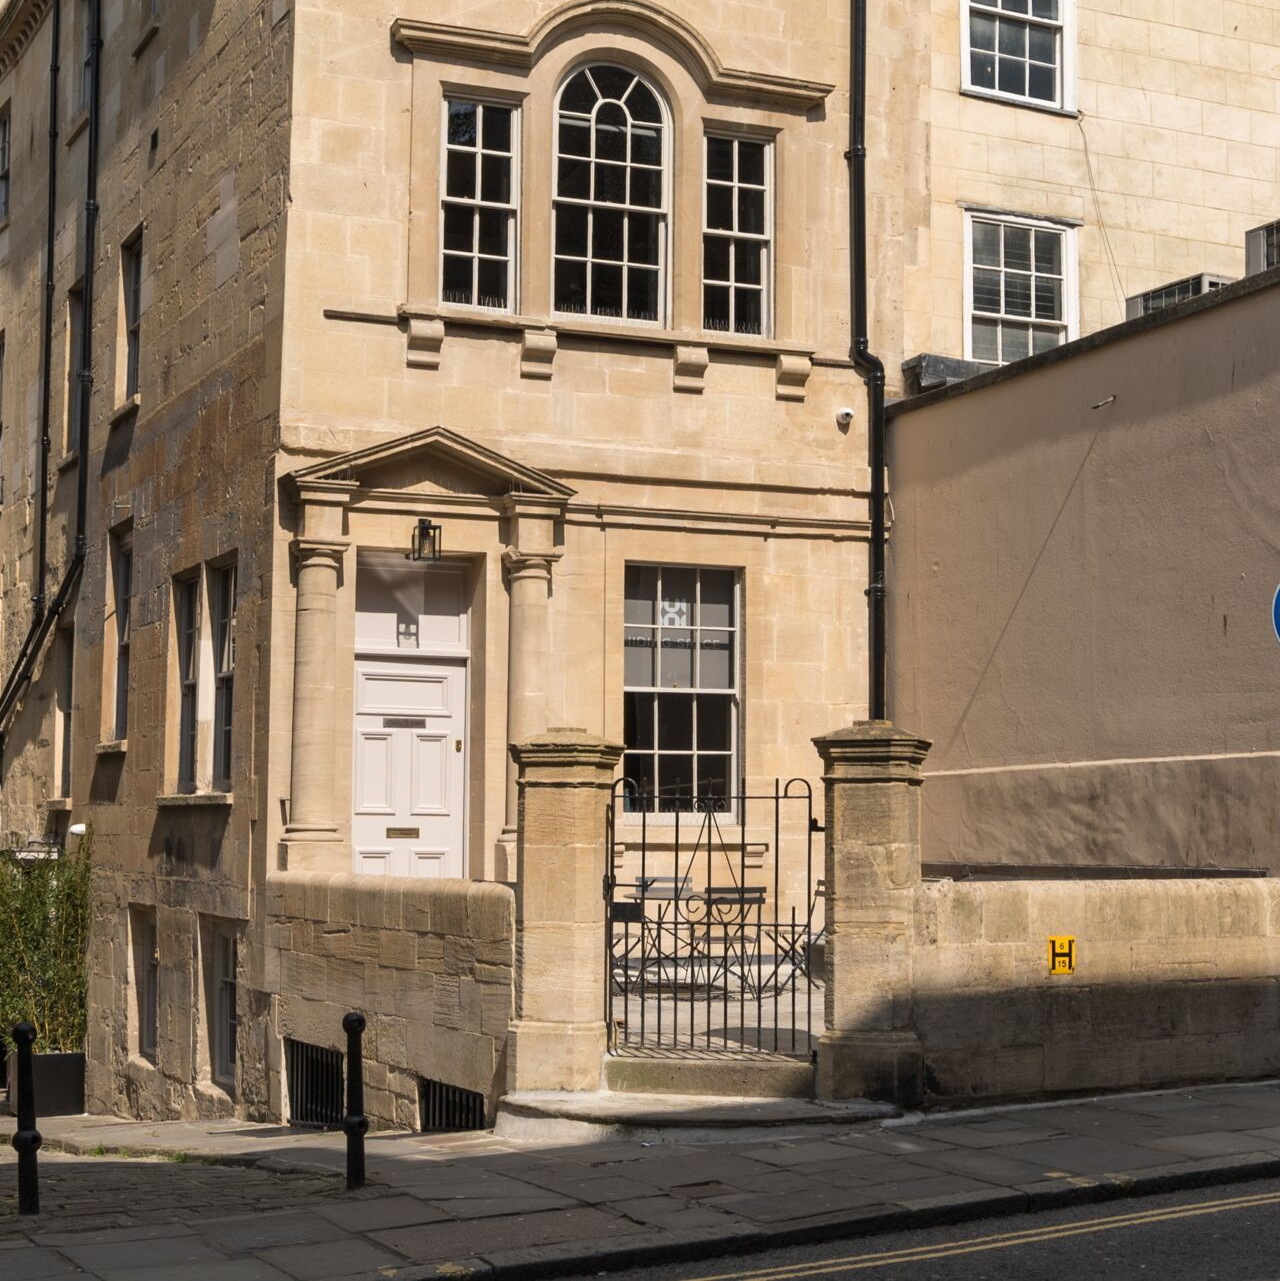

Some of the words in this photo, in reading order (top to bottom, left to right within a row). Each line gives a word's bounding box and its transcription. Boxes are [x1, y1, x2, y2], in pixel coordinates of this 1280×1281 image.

[1059, 942, 1065, 950] 6
[1051, 939, 1073, 970] H
[1058, 960, 1067, 968] 15
